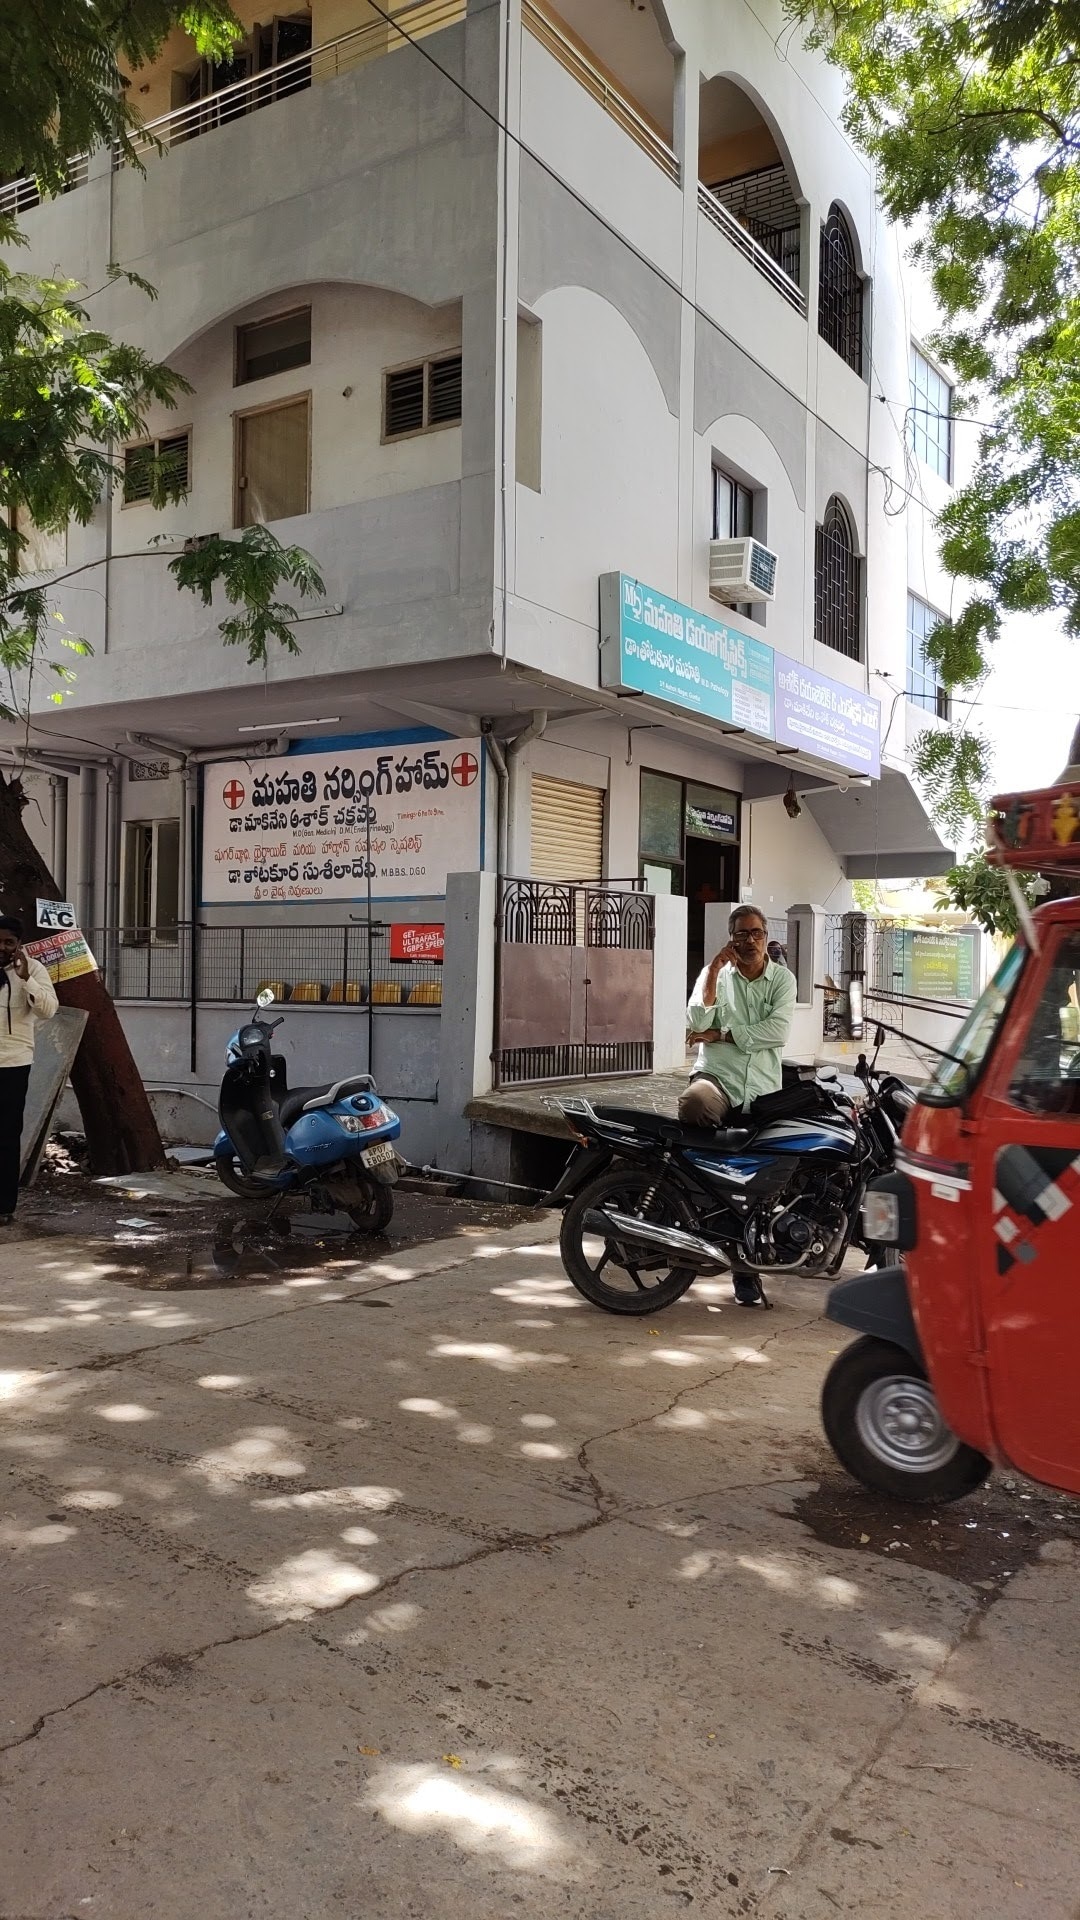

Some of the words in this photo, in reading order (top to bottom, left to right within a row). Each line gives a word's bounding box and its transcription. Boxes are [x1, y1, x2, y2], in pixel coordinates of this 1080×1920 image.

[645, 597, 683, 641] మహతి
[675, 658, 700, 684] మహతి
[252, 770, 317, 807] మహతి
[324, 756, 394, 804] నర్సింగ్
[395, 750, 449, 794] హోమ్
[244, 809, 288, 832] మాకినేని
[290, 805, 330, 828] అశోక్
[333, 804, 378, 826] చక్రవర్తి
[293, 842, 316, 856] మరియు
[322, 838, 351, 857] హార్మోన్
[288, 884, 323, 897] నిపుణులు
[403, 930, 416, 939] GET
[403, 932, 440, 946] ULTRAFAST
[27, 942, 41, 953] TOP
[403, 943, 424, 953] 1GBPS
